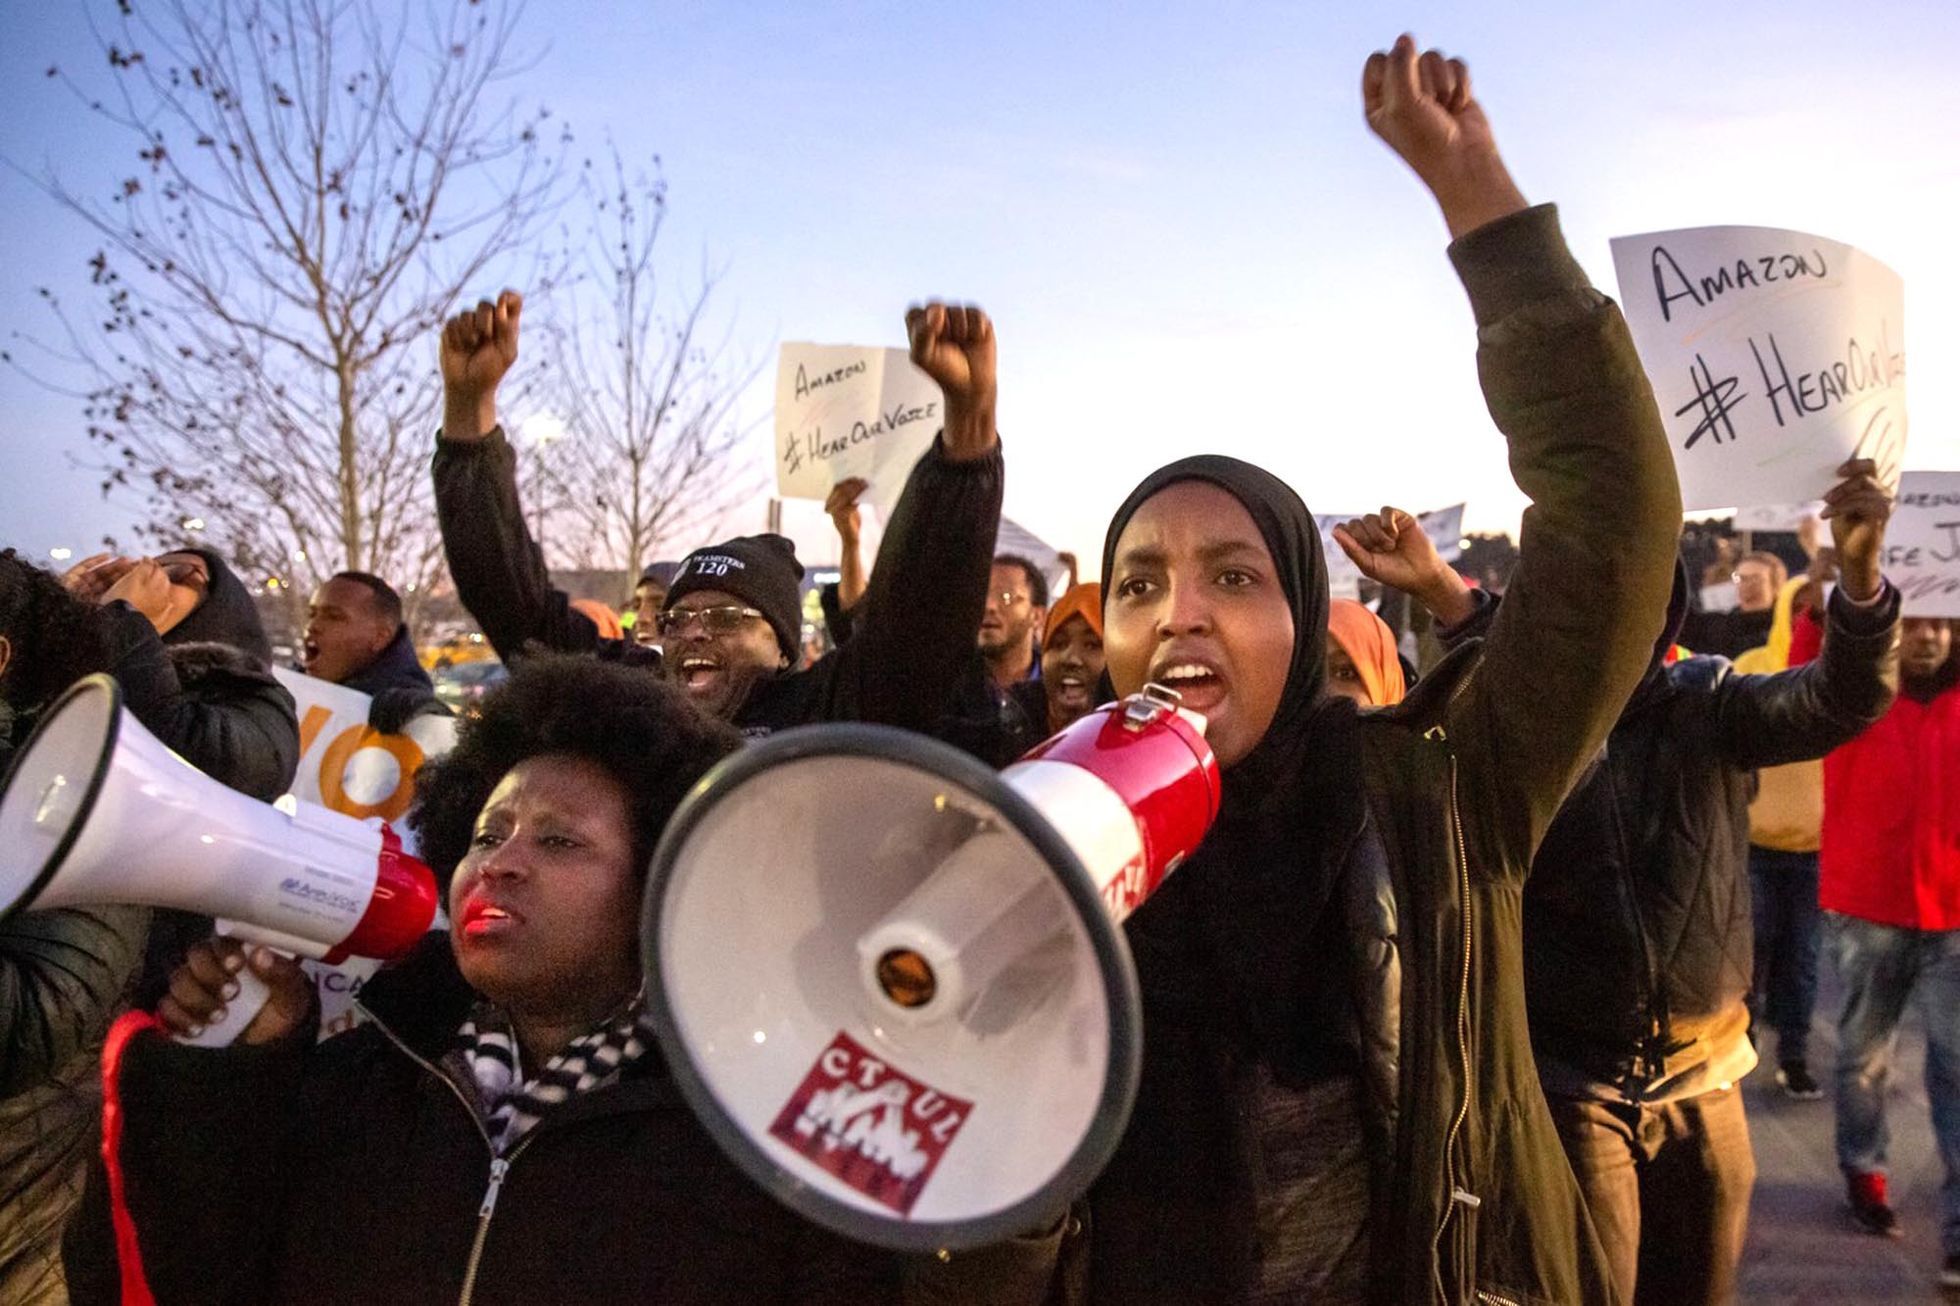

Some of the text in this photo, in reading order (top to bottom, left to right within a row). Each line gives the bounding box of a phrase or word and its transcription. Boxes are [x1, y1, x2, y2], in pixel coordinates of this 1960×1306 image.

[1652, 246, 1827, 322] AMAZON
[795, 361, 866, 402] AMAZON
[696, 562, 728, 577] 120
